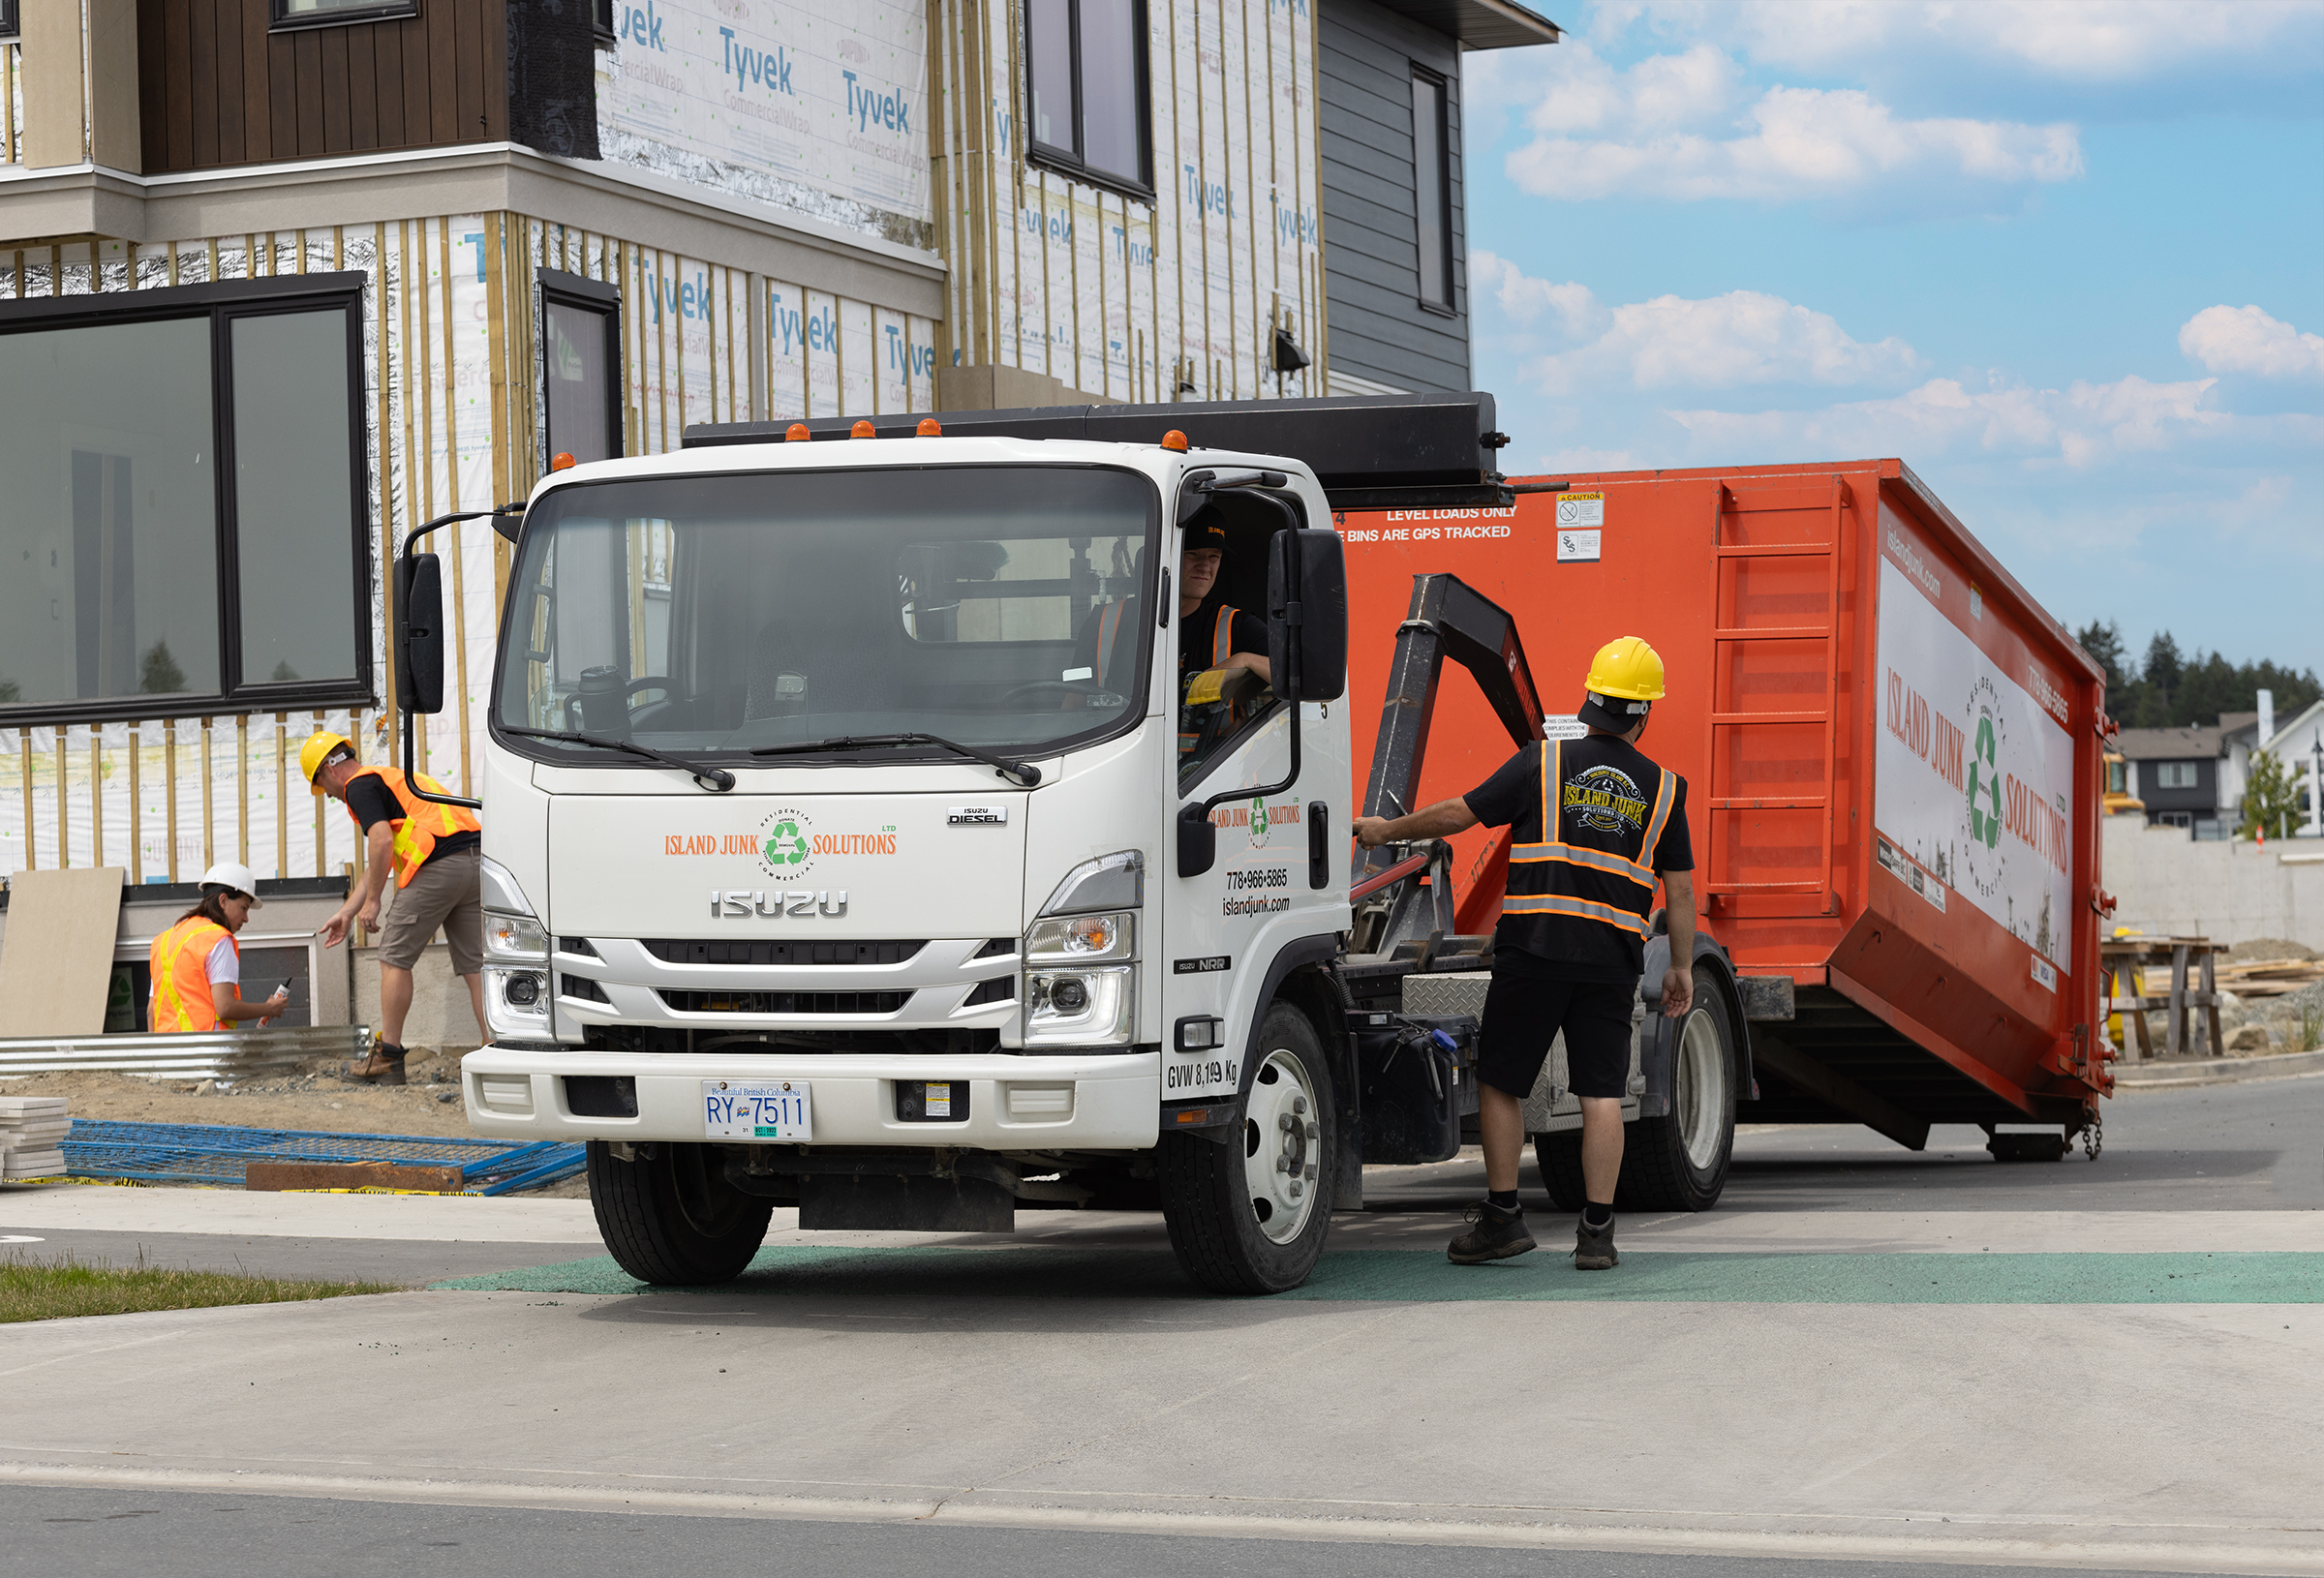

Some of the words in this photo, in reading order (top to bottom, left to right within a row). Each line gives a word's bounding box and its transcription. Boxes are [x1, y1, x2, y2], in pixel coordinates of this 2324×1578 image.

[719, 26, 793, 96] Tyvek
[724, 89, 810, 137] CommercialWrap
[842, 70, 908, 135] Tyvek
[1269, 194, 1318, 247] yvek
[633, 257, 711, 324] yvek
[766, 292, 839, 355] Tyvek
[1335, 511, 1346, 526] 4
[1387, 510, 1430, 521] LEVEL
[1433, 508, 1480, 520] LOADS
[1483, 505, 1517, 518] ONLY
[1347, 530, 1379, 542] BINS
[1382, 529, 1410, 541] ARE
[1413, 528, 1441, 540] GPS
[1444, 526, 1512, 539] TRACKED
[1886, 524, 1941, 599] islandjunk.com
[1966, 676, 2006, 744] RESIDENTIAL
[1886, 666, 1930, 762] ISLAND
[1932, 710, 1965, 795] JUNK
[2005, 773, 2066, 877] SOLUTIONS
[1563, 785, 1610, 806] ISLAND
[1611, 797, 1647, 826] JUNK
[1582, 806, 1615, 815] SOLUTIONS
[2056, 792, 2065, 813] LTD
[760, 808, 812, 827] RESIDENTIAL
[949, 814, 1004, 824] DIESEL
[1208, 808, 1231, 828] SLAND
[1232, 808, 1249, 828] JUNK
[1269, 805, 1300, 825] SOLUTIONS
[665, 835, 718, 856] ISLAND
[719, 835, 759, 856] JUNK
[812, 834, 897, 856] SOLUTIONS
[758, 862, 814, 881] COMMERCIAL
[711, 890, 848, 919] ISUZU
[1223, 895, 1290, 918] islandjunk.com
[1200, 958, 1226, 971] NRR
[1168, 1063, 1193, 1089] GVW
[1225, 1059, 1237, 1086] Kg
[712, 1087, 742, 1096] Beautiful
[767, 1088, 801, 1097] Columbia
[707, 1097, 734, 1123] RY
[749, 1097, 802, 1125] 7511
